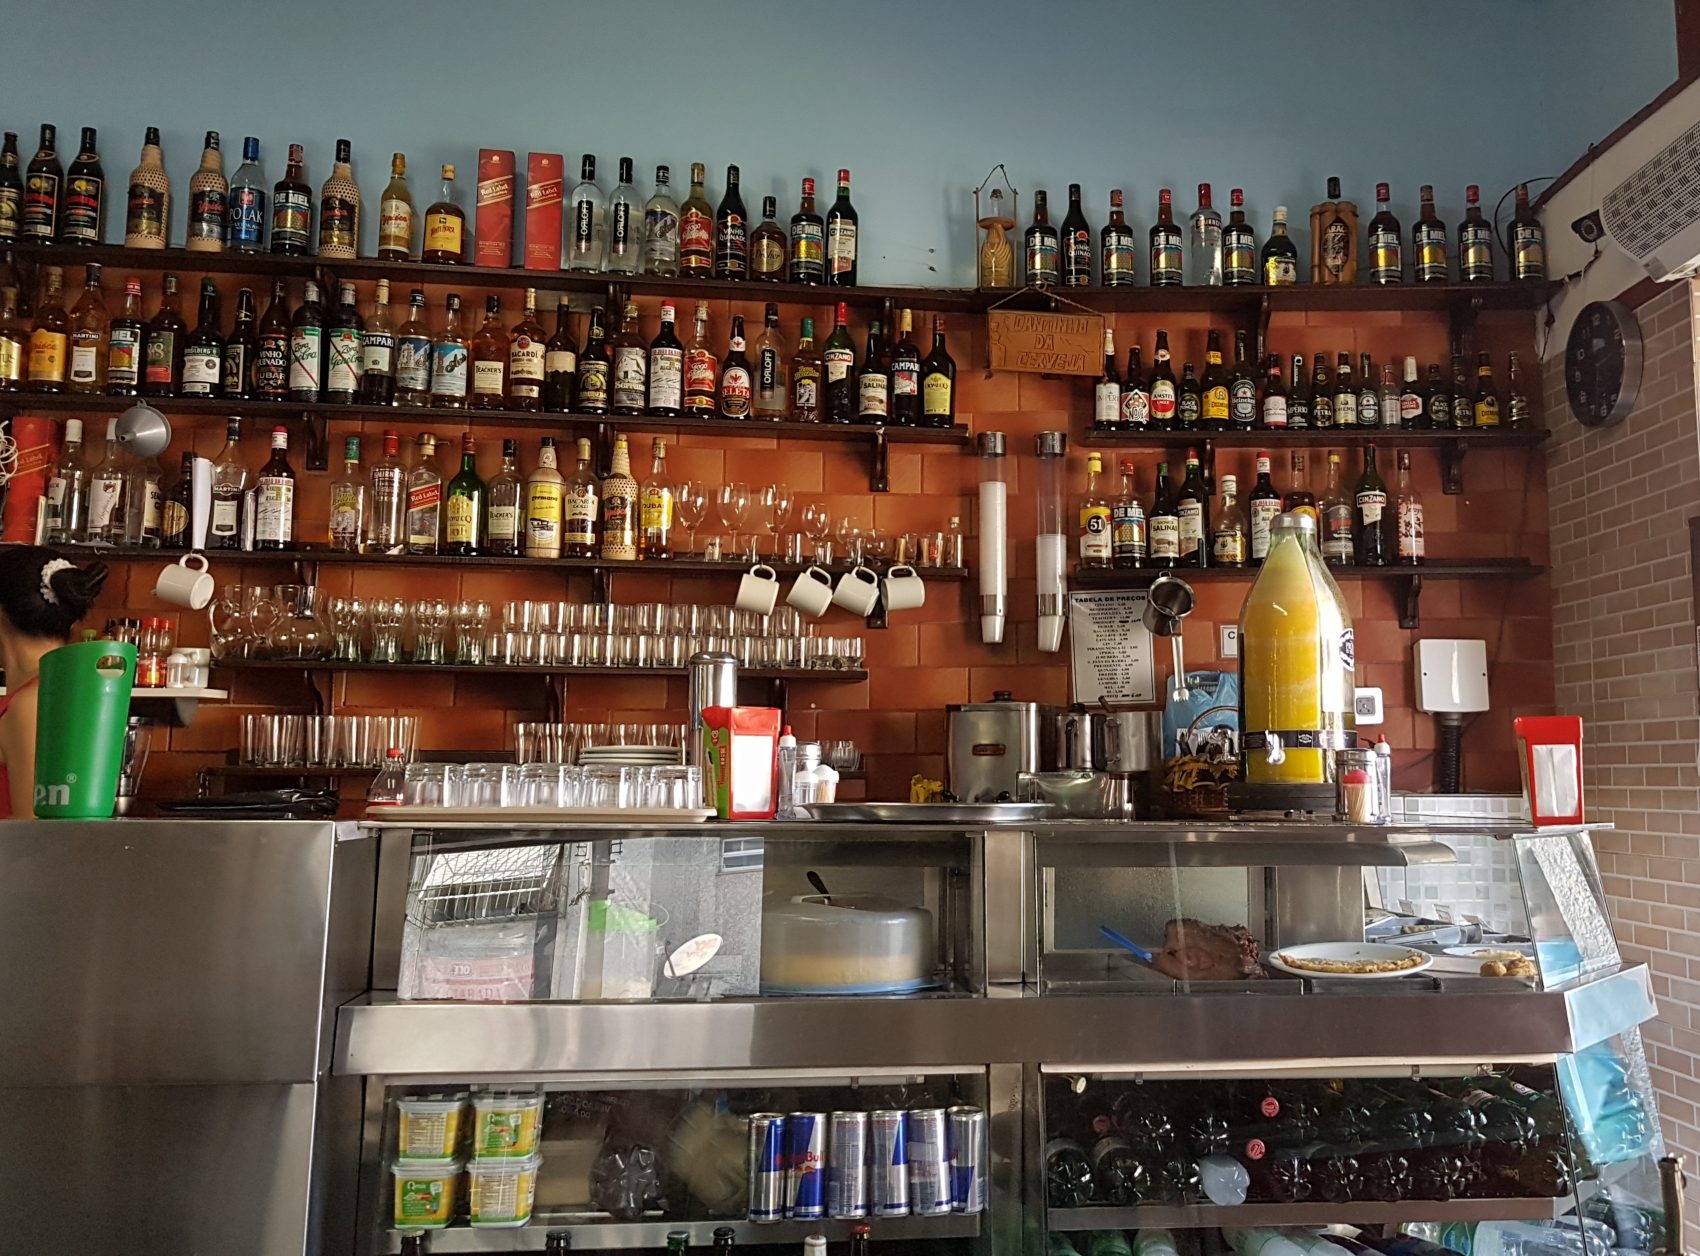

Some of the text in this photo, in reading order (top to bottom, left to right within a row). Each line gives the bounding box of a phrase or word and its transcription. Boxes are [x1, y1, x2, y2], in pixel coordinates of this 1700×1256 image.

[274, 193, 310, 207] DE MEL
[229, 207, 263, 224] POLAK
[792, 225, 822, 236] DE MEL
[830, 228, 854, 238] CNZANO
[1462, 231, 1475, 241] DE
[1518, 230, 1531, 240] DE
[1029, 236, 1043, 247] DE
[1106, 236, 1118, 247] DE
[1154, 236, 1167, 246] DE
[1225, 235, 1255, 247] DE MEL
[1379, 234, 1399, 244] MEL
[1416, 231, 1428, 242] DE
[112, 330, 135, 341] MEL
[362, 336, 394, 347] CAMPARI
[1034, 334, 1054, 350] DA
[825, 352, 851, 361] CINZANO
[1017, 353, 1086, 371] CERVEJA
[476, 366, 502, 374] TEACHER'S
[764, 352, 772, 382] ORLOFF
[892, 362, 920, 372] CAMPARI
[213, 484, 240, 494] MARTINI
[411, 489, 440, 502] Red Label
[1358, 495, 1385, 504] CINZANO
[489, 511, 514, 520] TEACHER'S
[1114, 507, 1145, 518] DE MEL
[1089, 518, 1104, 532] 51
